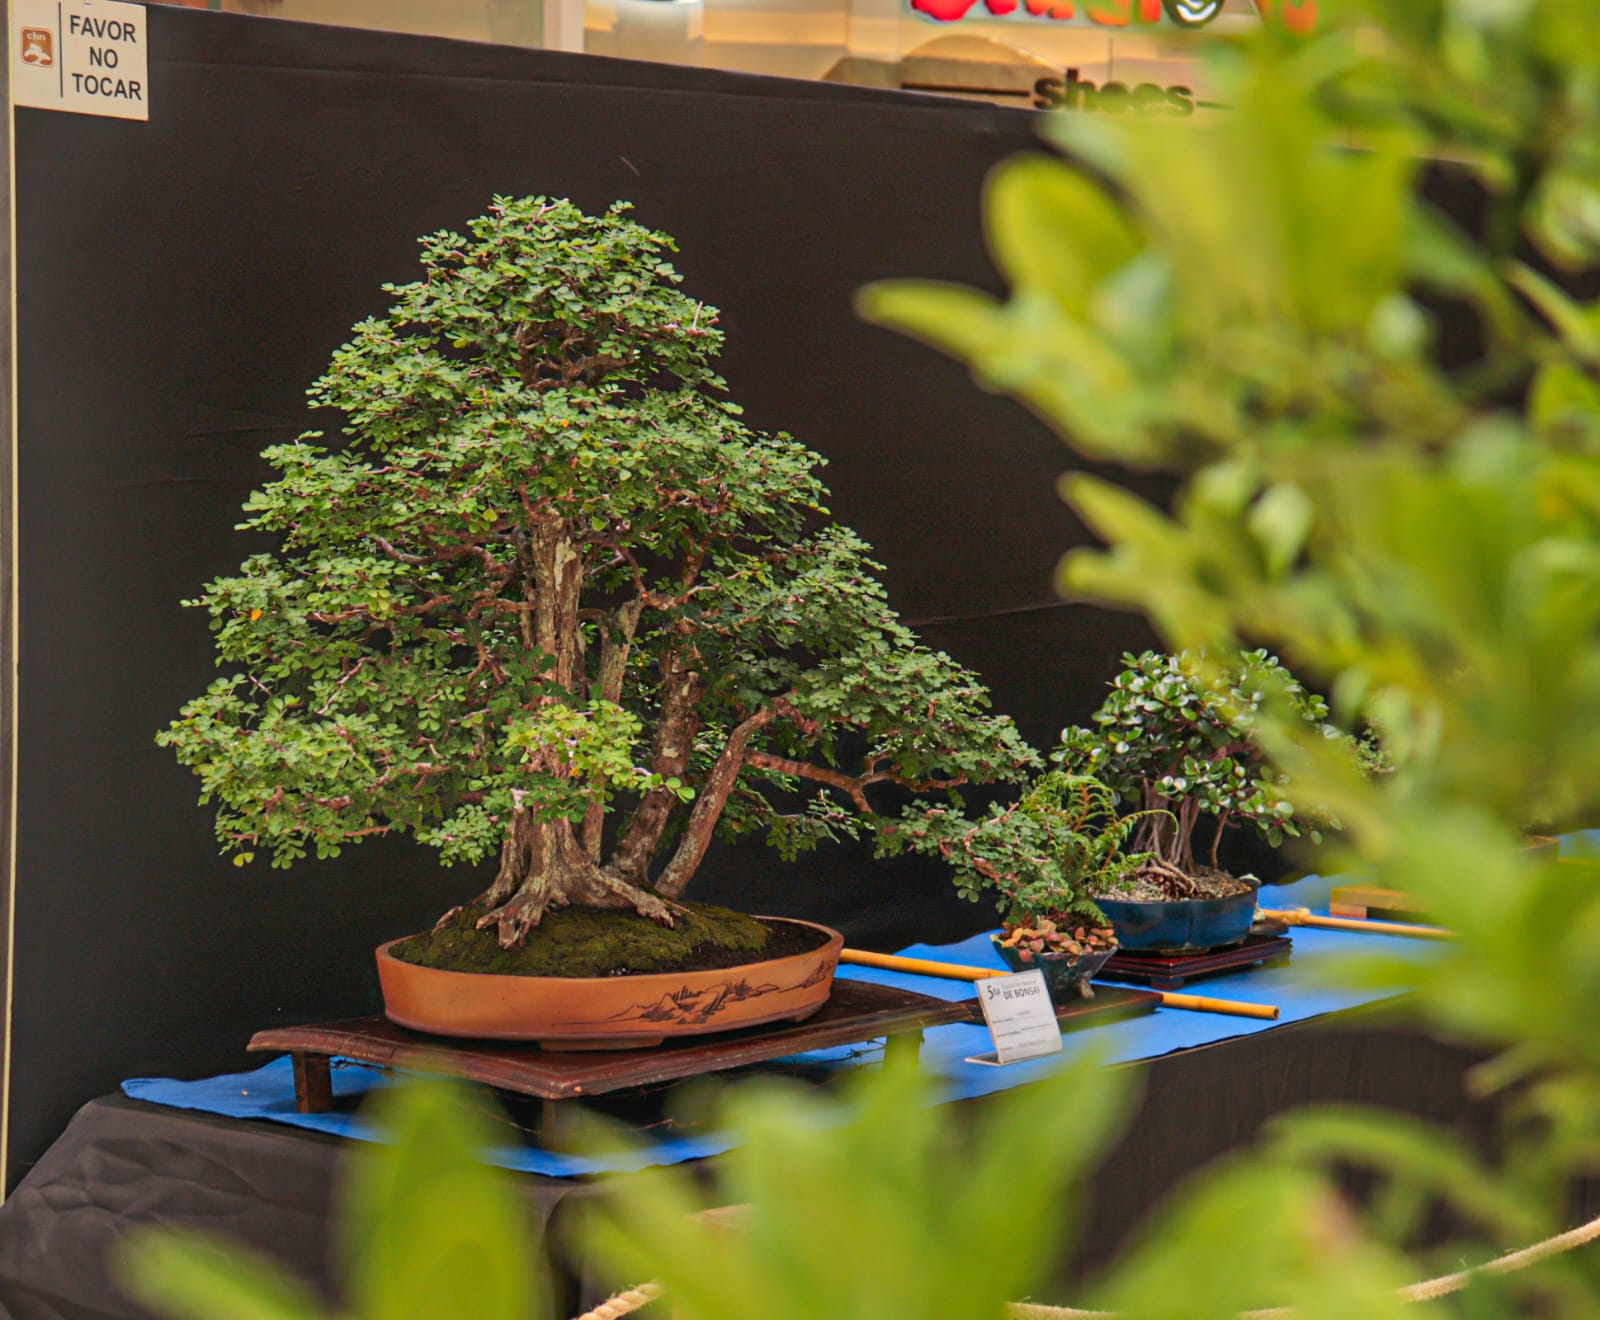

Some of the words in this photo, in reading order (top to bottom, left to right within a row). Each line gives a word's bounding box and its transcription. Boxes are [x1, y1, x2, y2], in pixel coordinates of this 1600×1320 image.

[70, 14, 137, 43] FAVOR
[89, 46, 119, 69] NO
[71, 73, 142, 100] TOCAR
[1034, 68, 1194, 117] shoes
[1003, 990, 1014, 1000] DE
[1015, 986, 1040, 998] BONSAI
